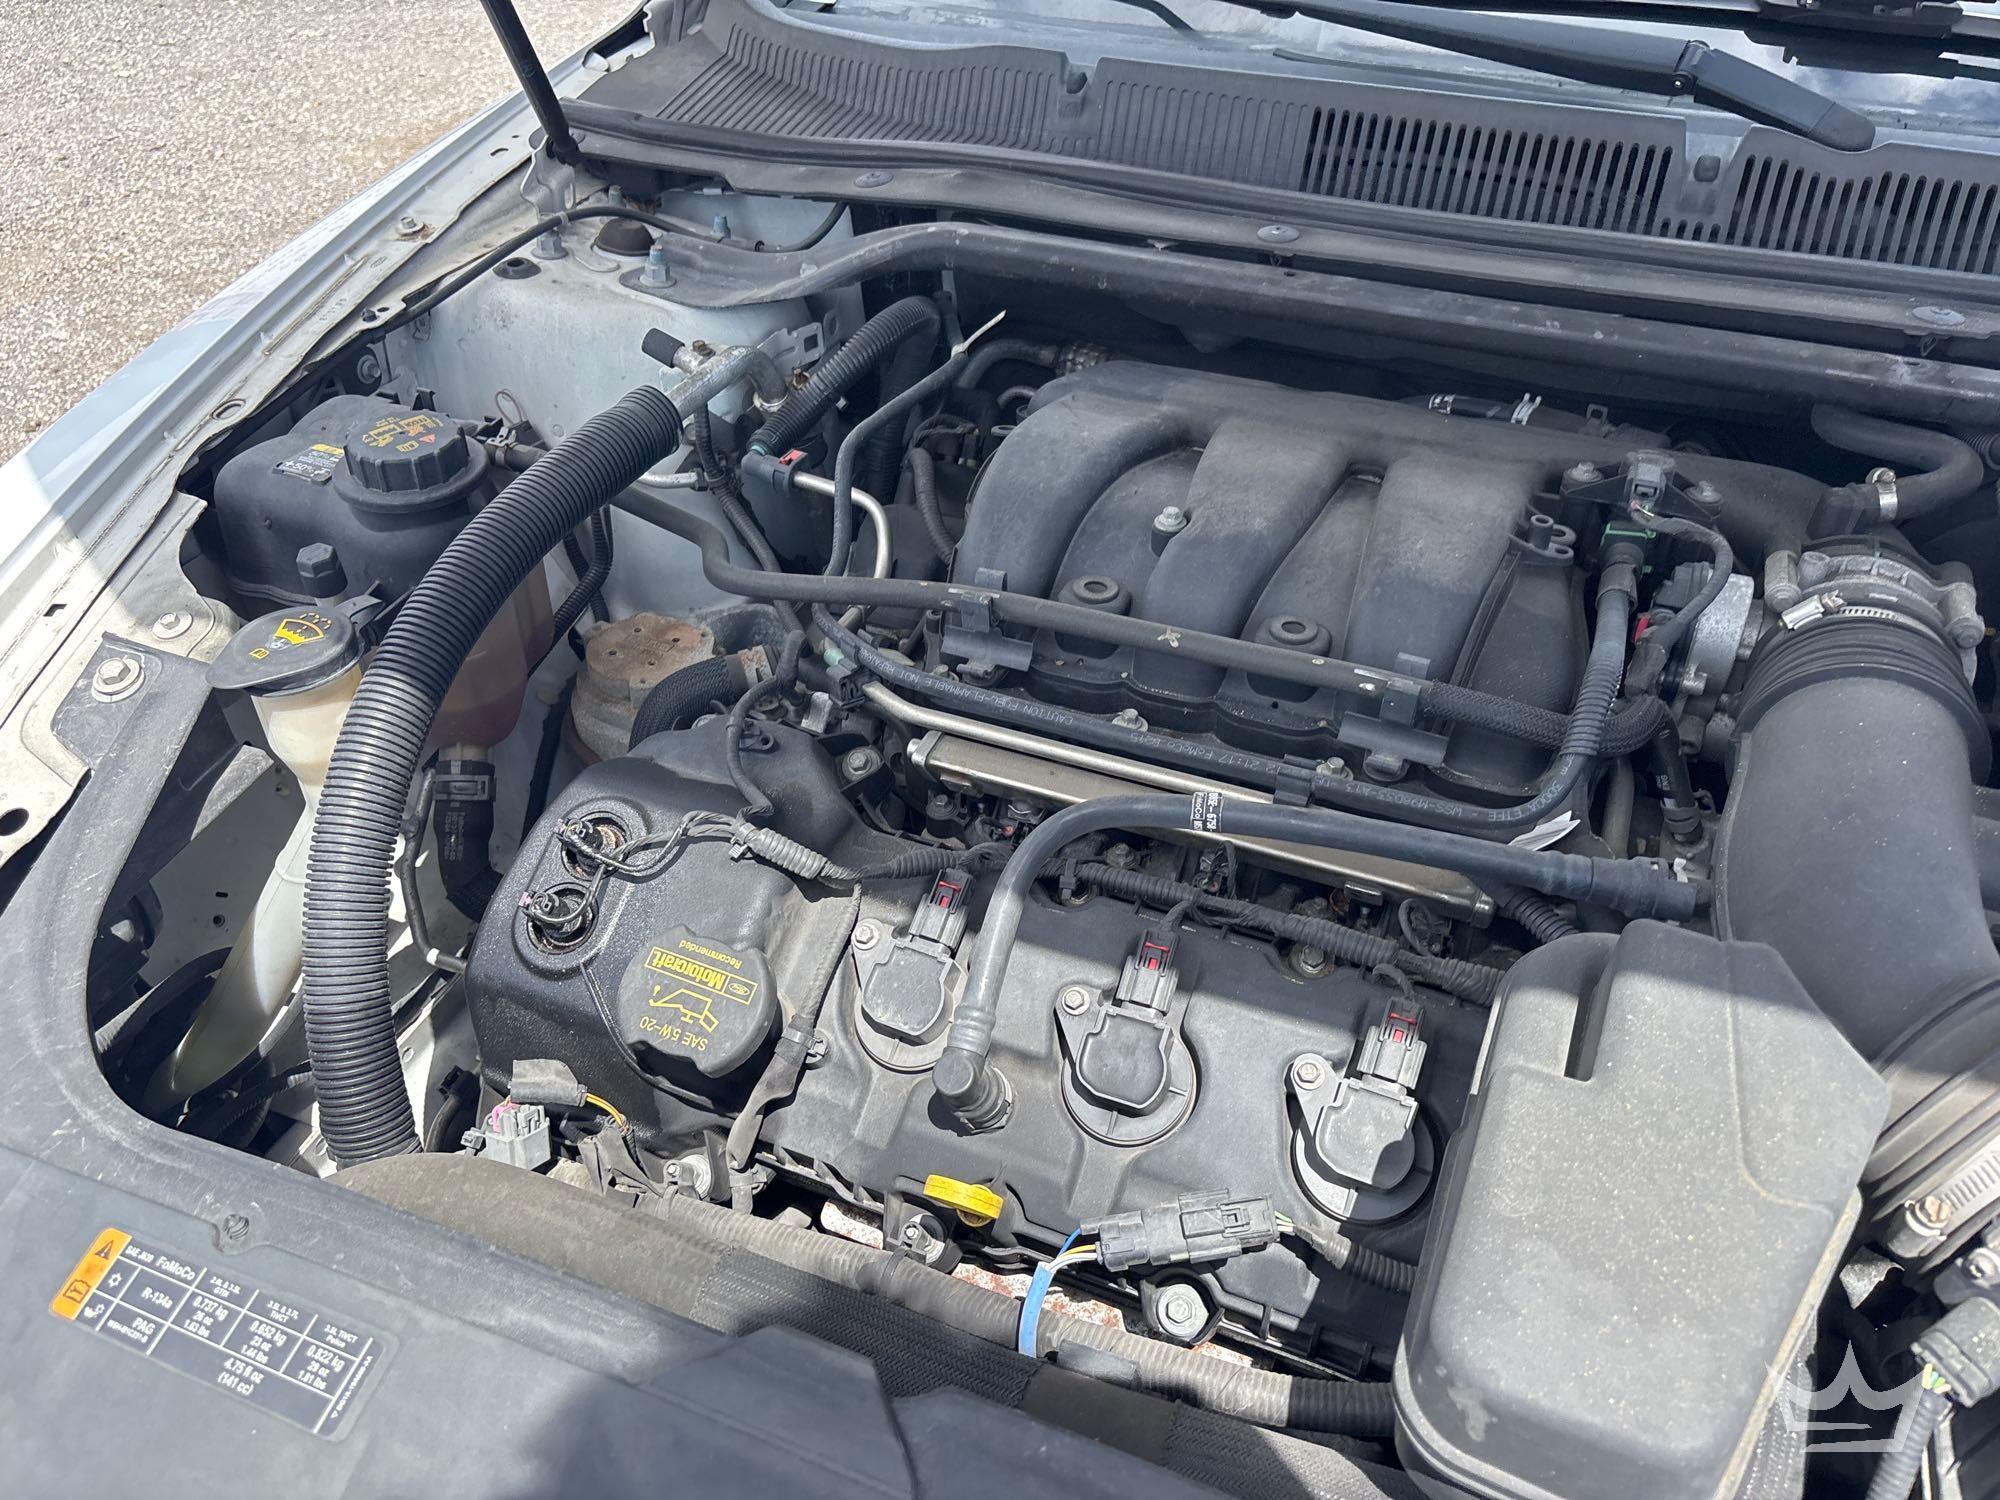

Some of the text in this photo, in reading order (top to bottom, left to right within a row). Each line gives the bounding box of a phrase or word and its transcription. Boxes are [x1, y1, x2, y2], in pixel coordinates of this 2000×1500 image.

[1022, 704, 1073, 725] CAUTION
[1166, 739, 1213, 758] FoMoCo
[678, 940, 742, 969] Recommended
[650, 951, 726, 990] Motorcraft
[638, 1015, 709, 1052] SAE 5W-20
[126, 1245, 139, 1256] SAE
[155, 1256, 196, 1280] FoMoCo
[141, 1287, 173, 1308] R-134a
[193, 1296, 228, 1320] 0.737 kg
[132, 1317, 155, 1334] PAG
[197, 1327, 210, 1337] lbs
[249, 1320, 287, 1346] 0.652 kg
[251, 1336, 262, 1346] 23
[240, 1345, 268, 1362] 1.44 lbs
[306, 1345, 345, 1371] 0.822 kg
[223, 1357, 245, 1373] 4.75
[250, 1371, 263, 1382] oz
[308, 1361, 319, 1371] 29
[217, 1371, 253, 1395] (141 cc)
[313, 1377, 327, 1389] lbs
